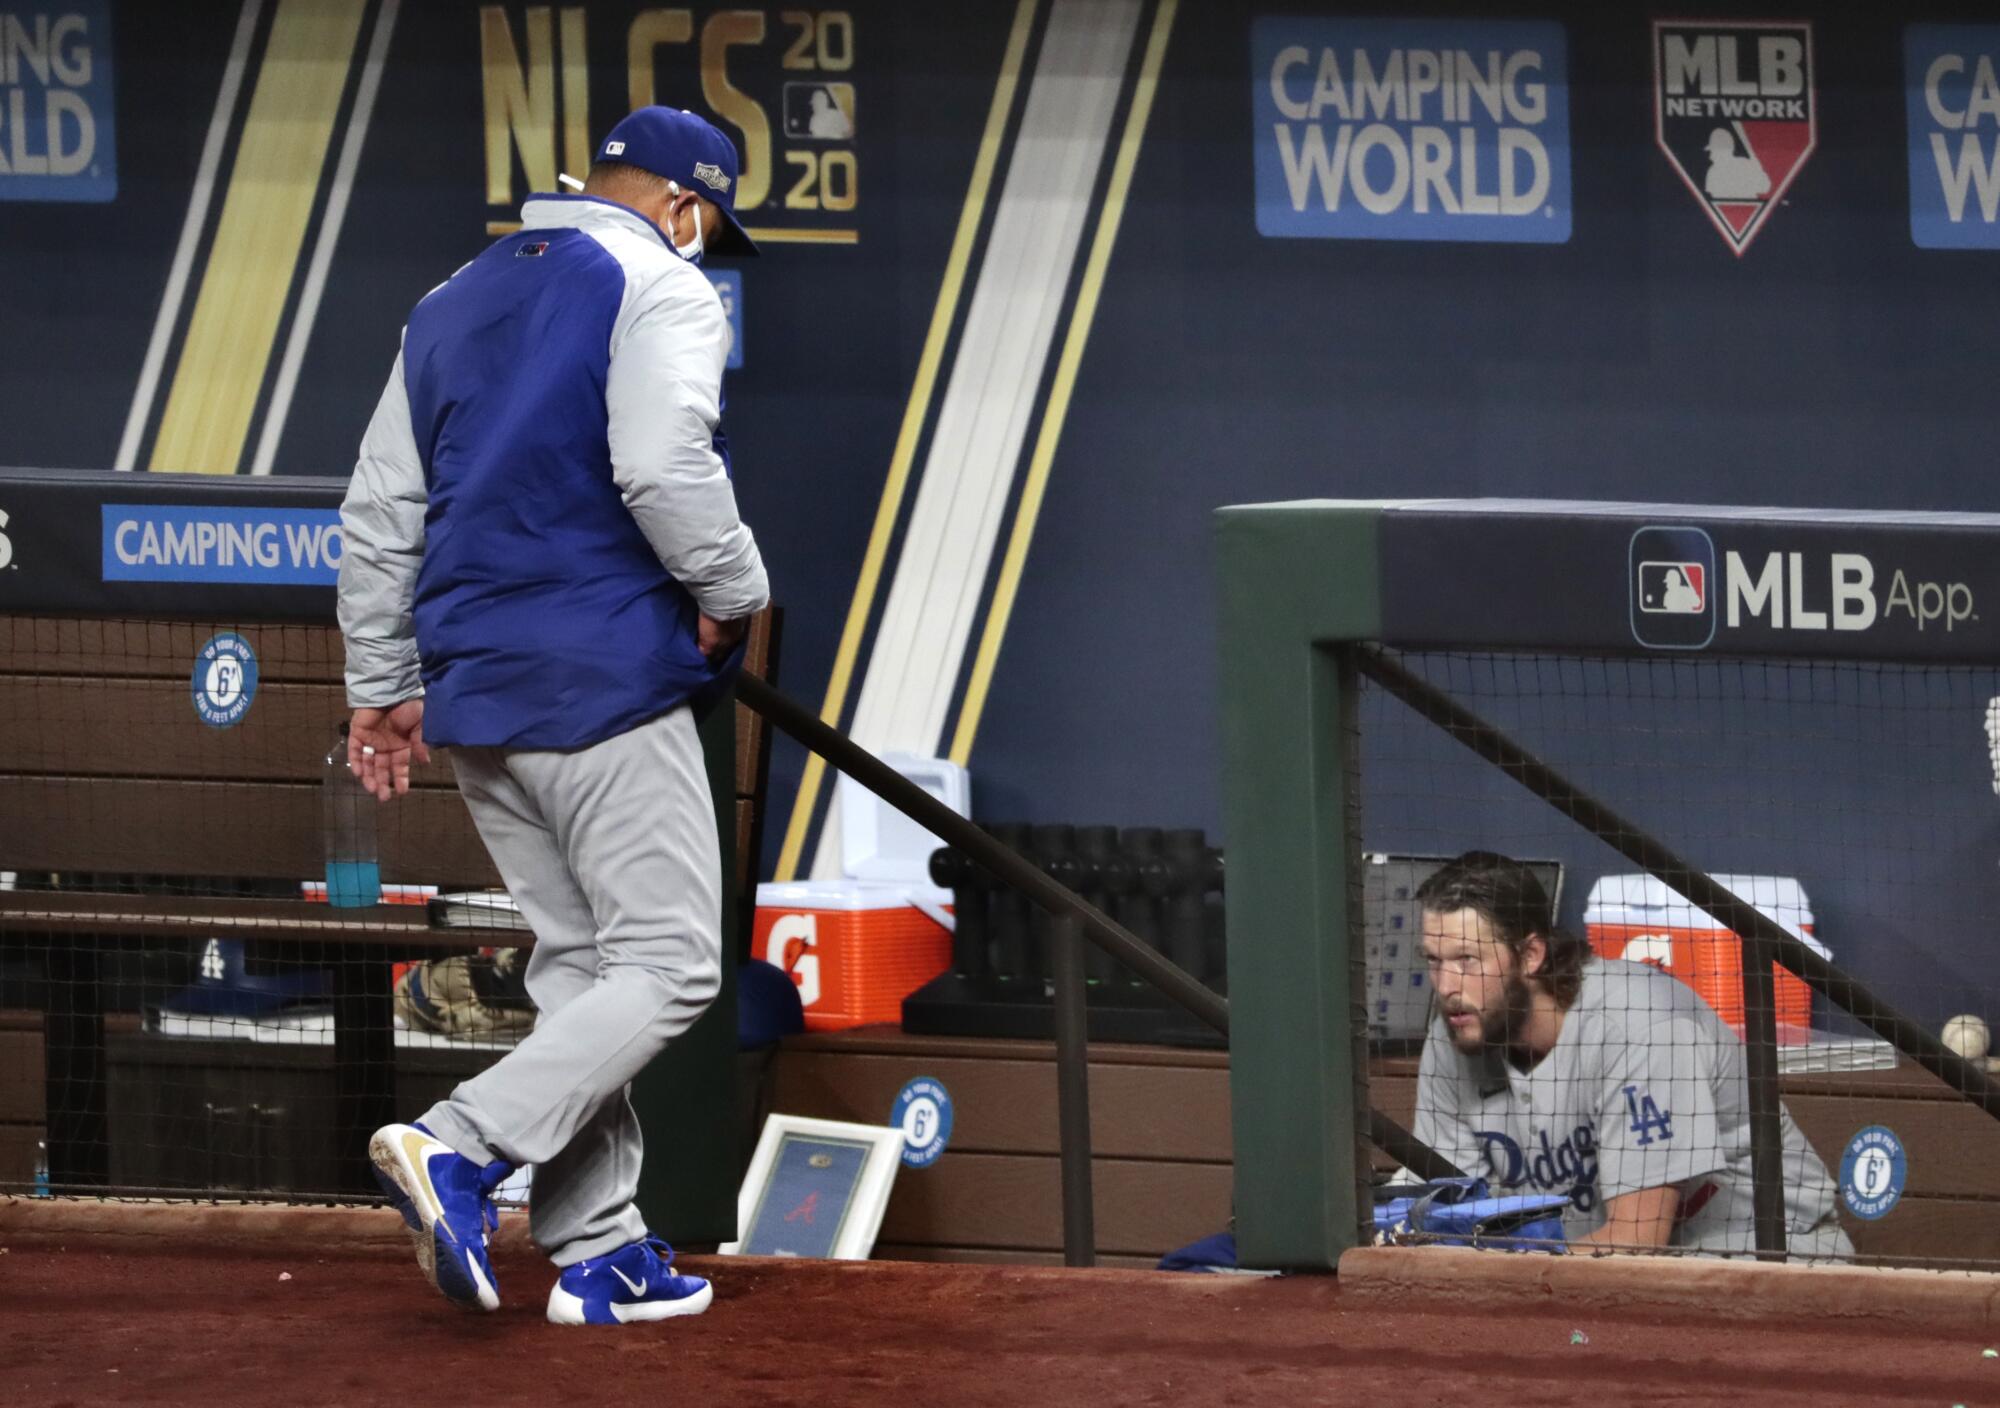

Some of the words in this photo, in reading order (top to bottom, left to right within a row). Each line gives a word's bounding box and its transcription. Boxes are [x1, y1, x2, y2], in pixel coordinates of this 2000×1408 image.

[0, 13, 92, 87] NG
[782, 11, 853, 71] 20
[1664, 34, 1803, 96] MLB
[1270, 46, 1547, 125] CAMPING
[1666, 98, 1805, 119] NETWORK
[785, 150, 857, 211] 20
[1273, 123, 1551, 216] WORLD
[115, 520, 280, 567] CAMPING
[1726, 550, 1877, 631] MLB
[766, 913, 821, 1007] G
[1622, 1085, 1674, 1146] LA
